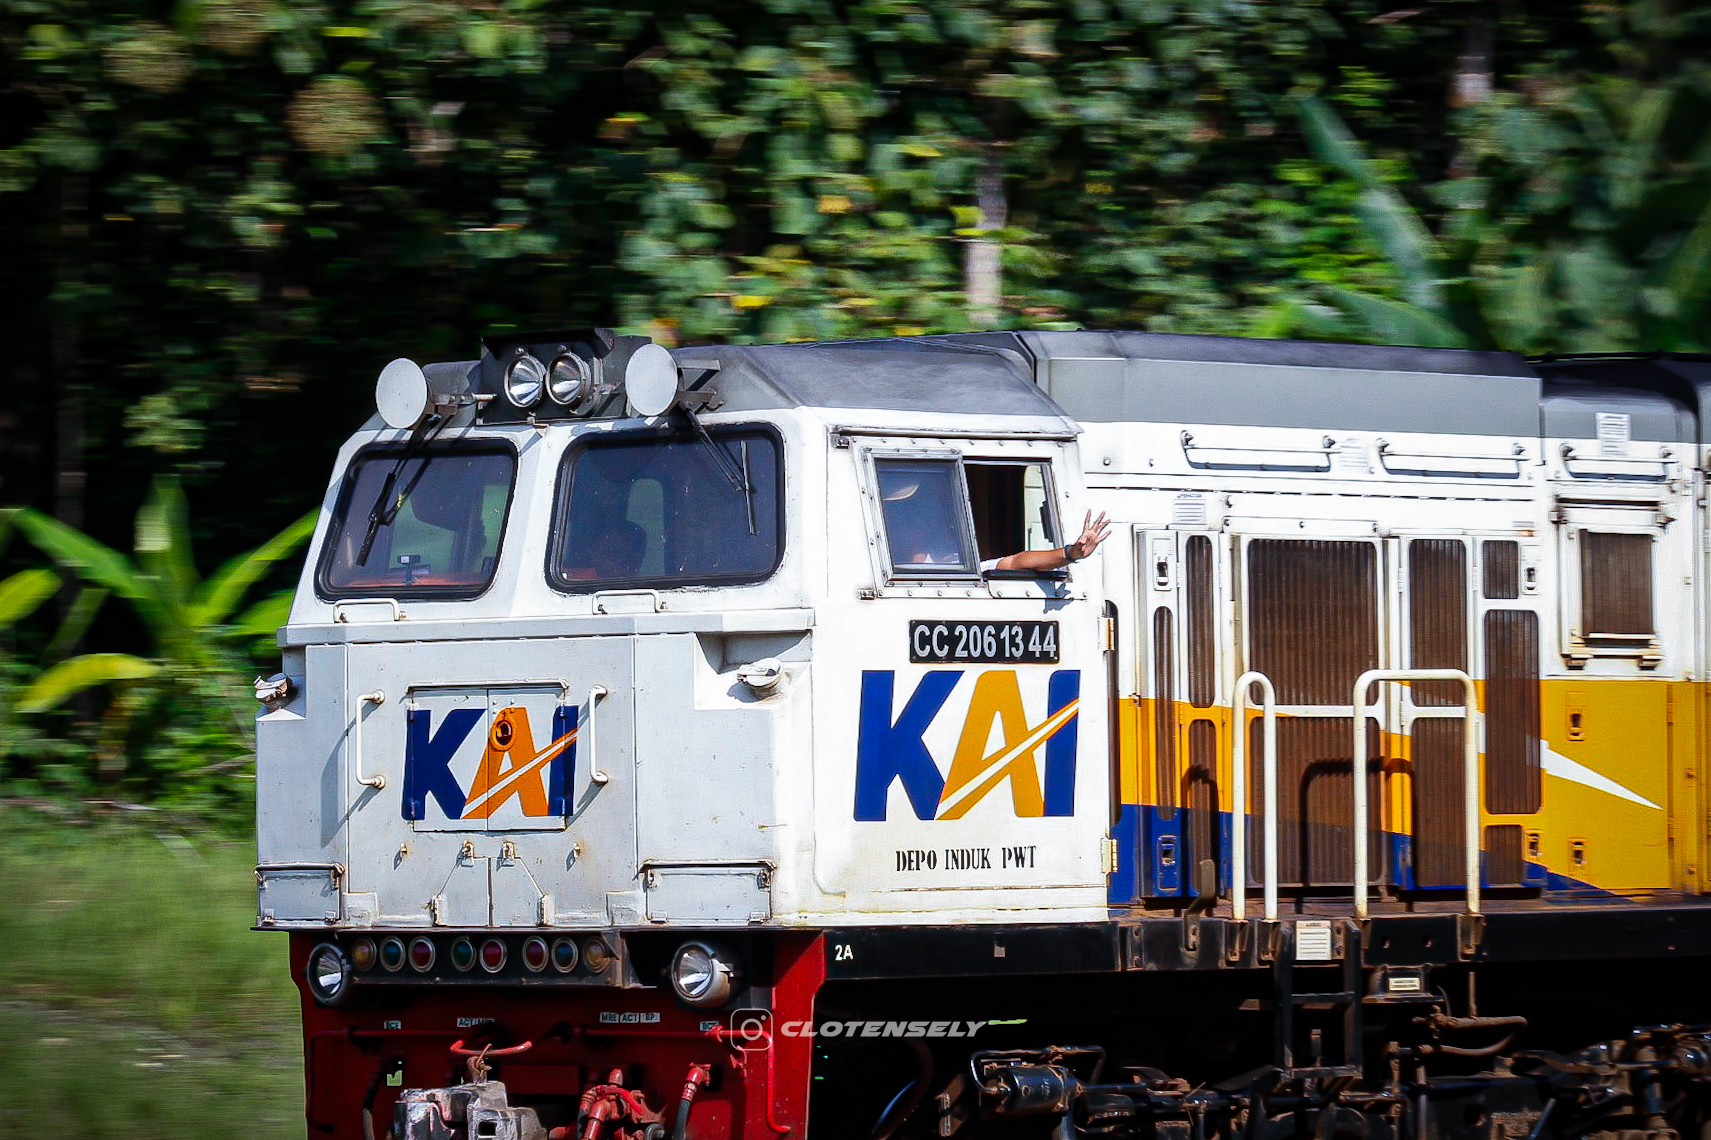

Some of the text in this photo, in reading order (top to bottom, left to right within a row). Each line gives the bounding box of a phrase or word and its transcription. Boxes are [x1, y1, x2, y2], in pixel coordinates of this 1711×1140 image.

[913, 625, 1057, 658] CC 206 13 44
[854, 670, 1081, 821] KAI
[401, 705, 579, 820] KAI
[895, 846, 1037, 871] DEPO INDUK PWT
[835, 944, 854, 961] 2A
[621, 1014, 637, 1022] ACT
